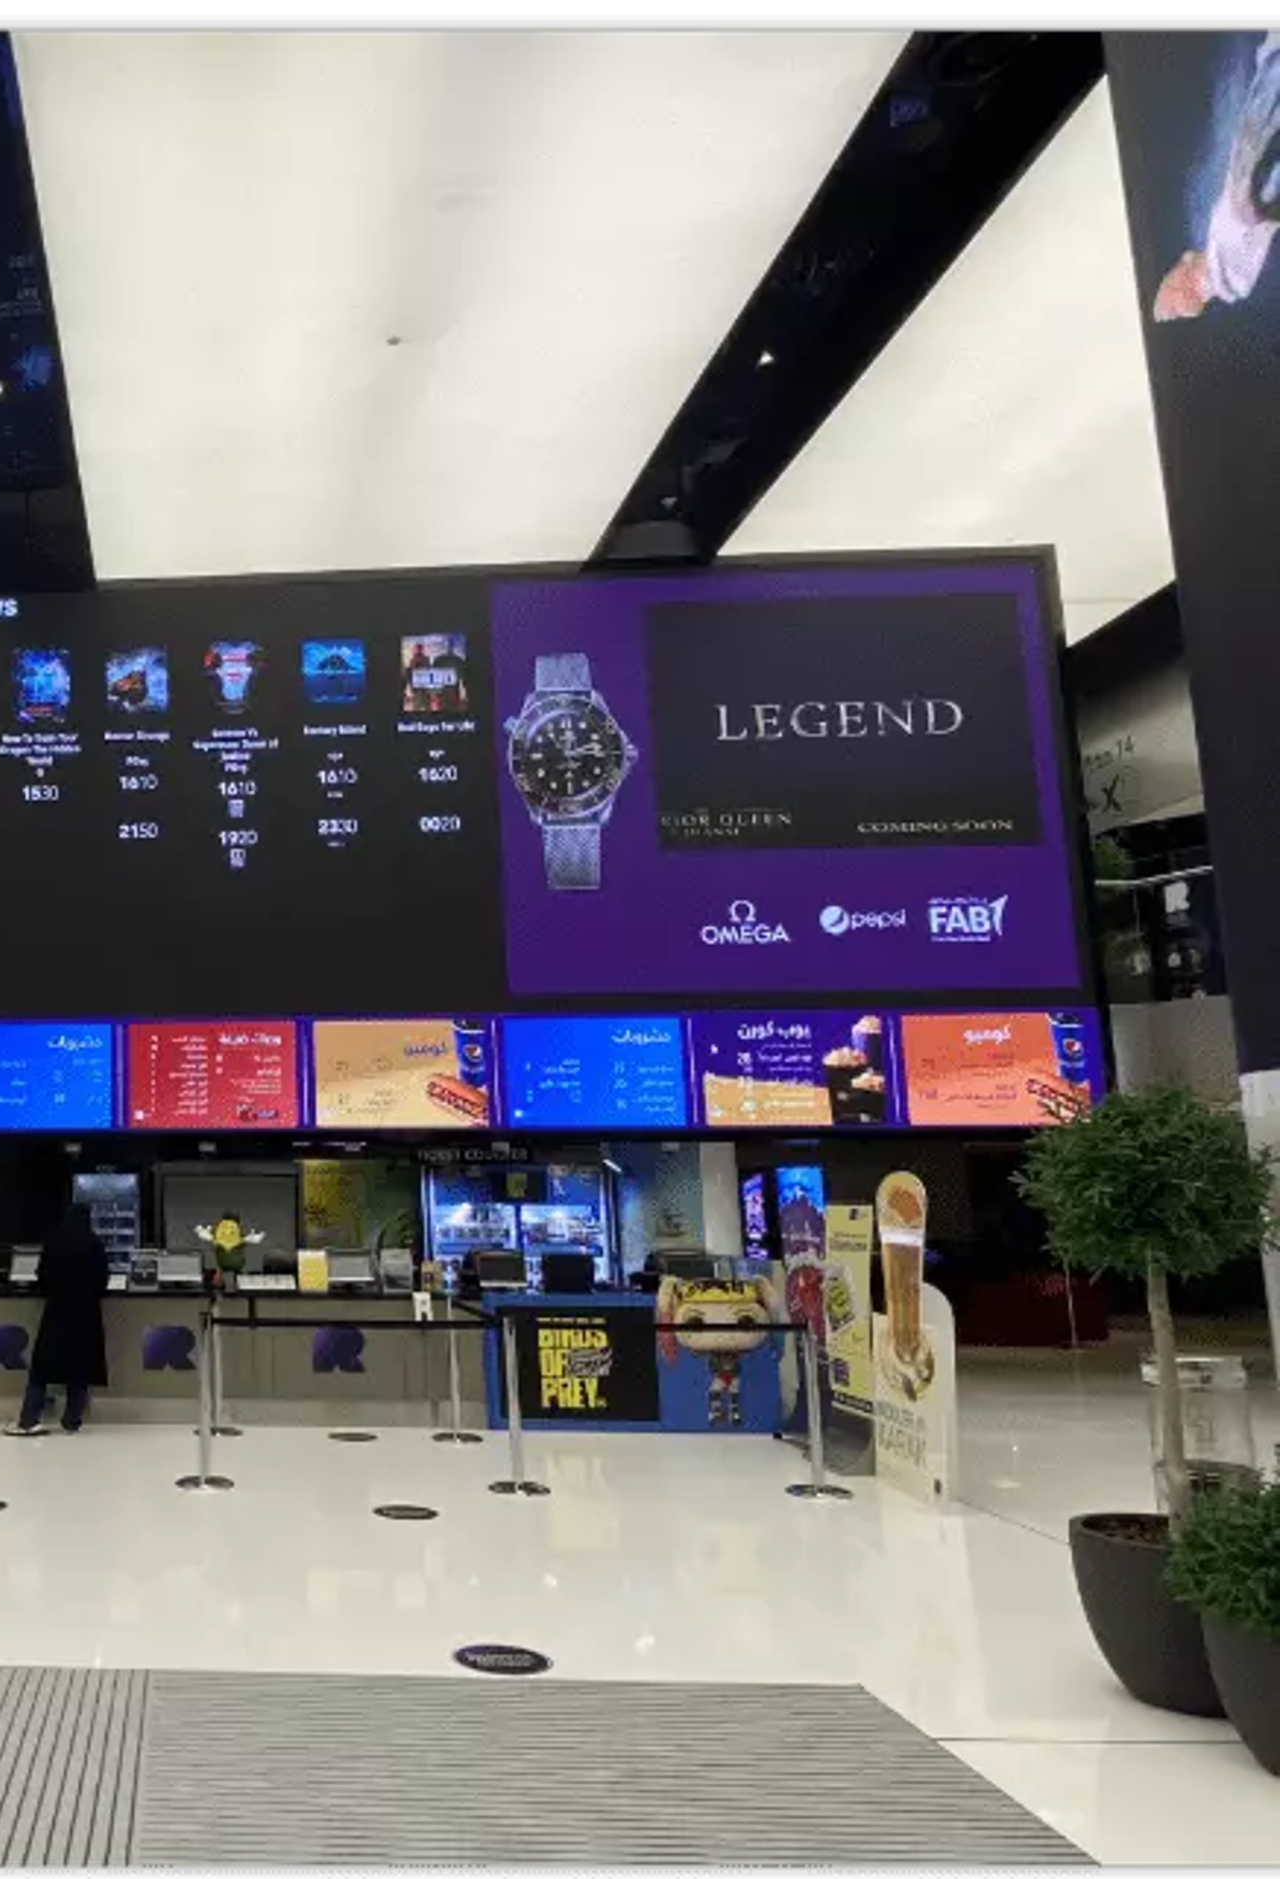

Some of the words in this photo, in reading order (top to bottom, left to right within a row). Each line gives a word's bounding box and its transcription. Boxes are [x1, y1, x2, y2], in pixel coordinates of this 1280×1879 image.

[717, 699, 965, 741] LEGEND
[22, 784, 60, 800] 1530
[119, 822, 159, 839] 2150
[857, 820, 948, 834] COMING
[951, 819, 1014, 832] SOON
[851, 908, 907, 931] pepsi
[928, 904, 991, 934] FAB
[700, 924, 792, 945] OMEGA
[537, 1328, 608, 1348] BIRDS
